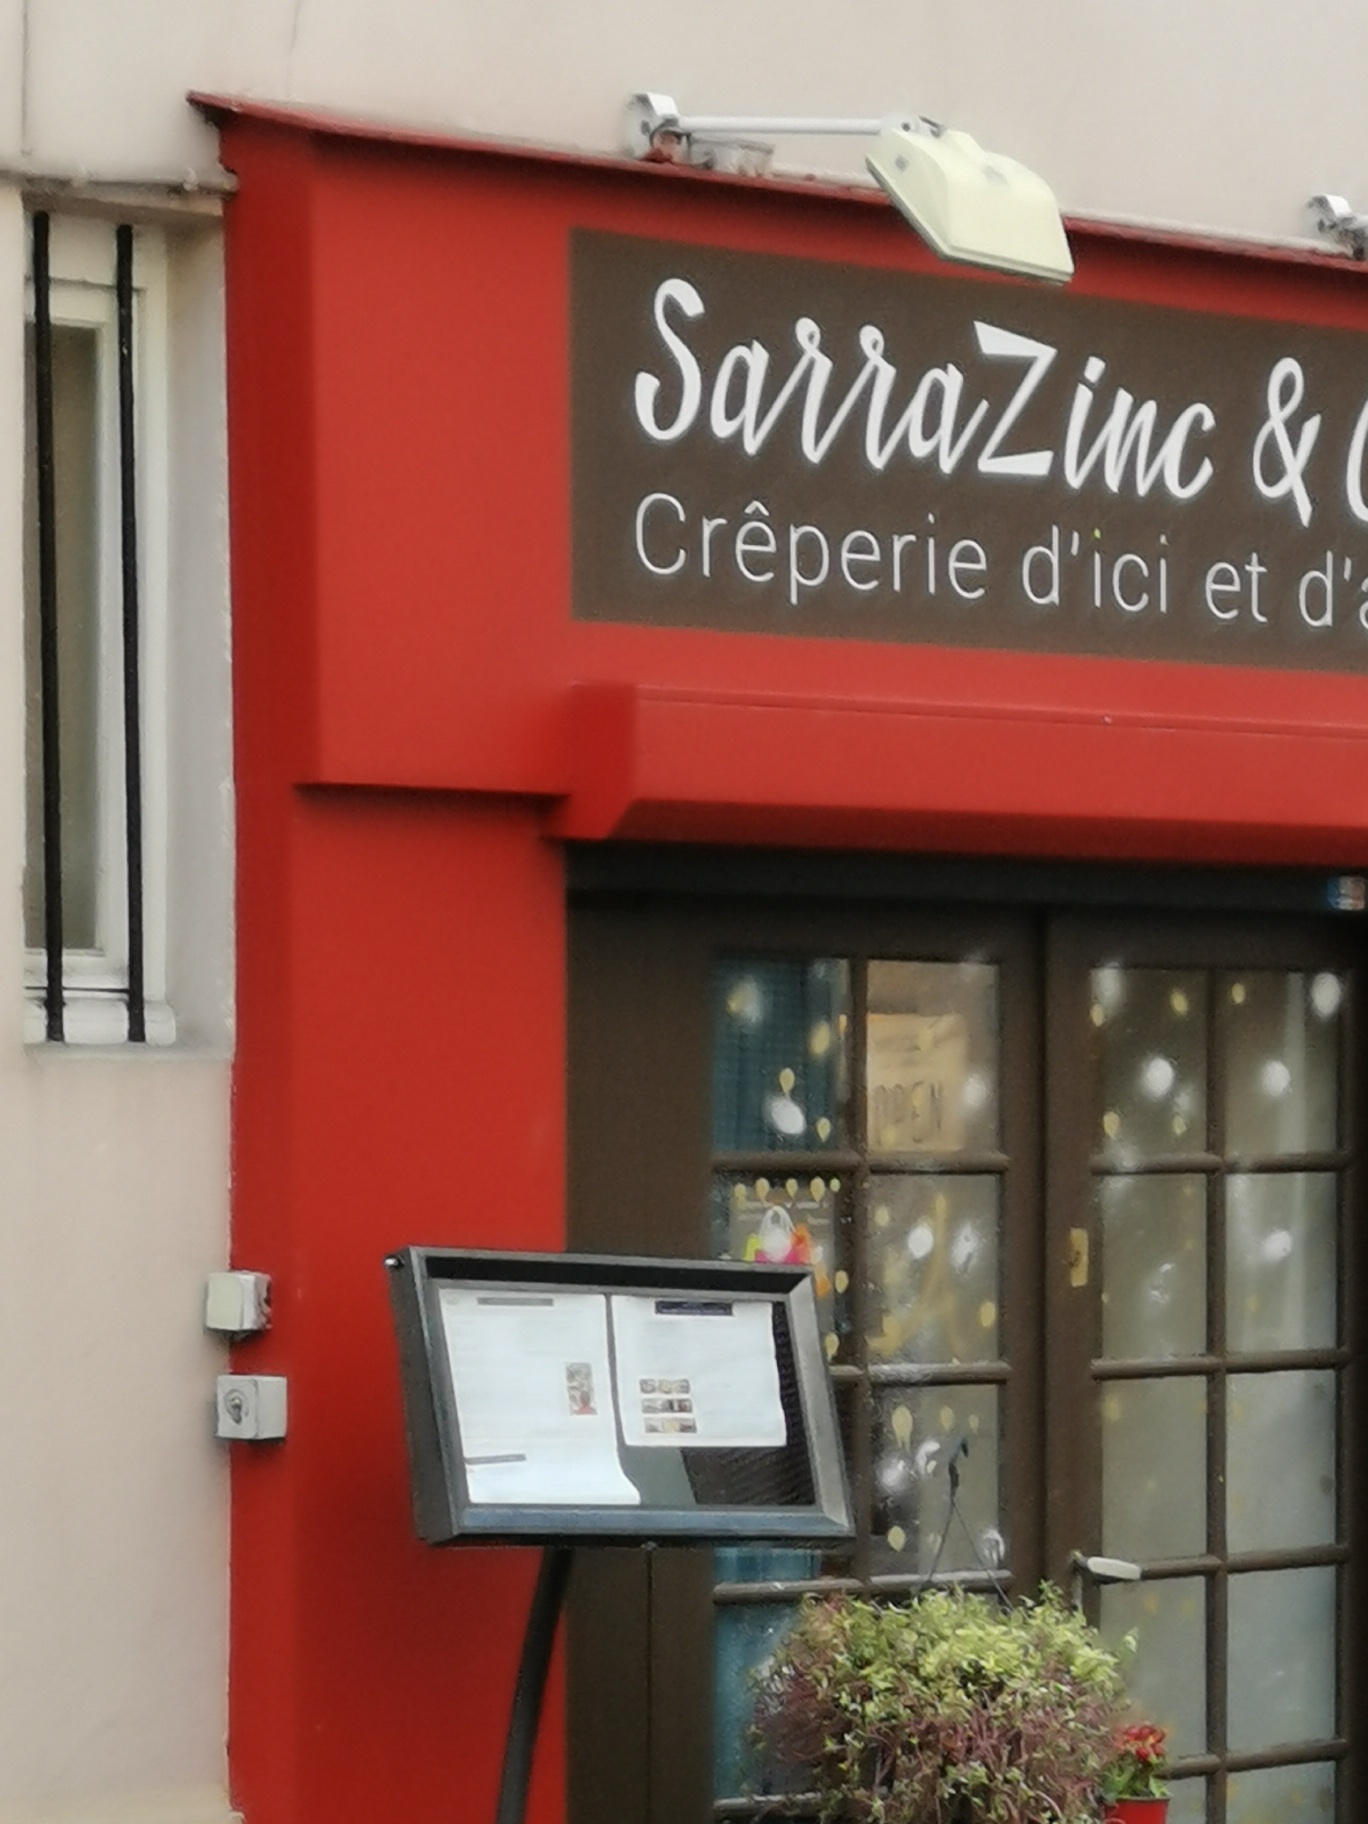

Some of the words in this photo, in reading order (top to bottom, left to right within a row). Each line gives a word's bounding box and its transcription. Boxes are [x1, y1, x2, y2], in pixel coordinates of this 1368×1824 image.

[633, 277, 1217, 501] SarraZinc
[1251, 356, 1322, 529] &
[634, 491, 988, 606] Crêperie
[1021, 524, 1169, 614] d'ici
[1204, 551, 1269, 624] et
